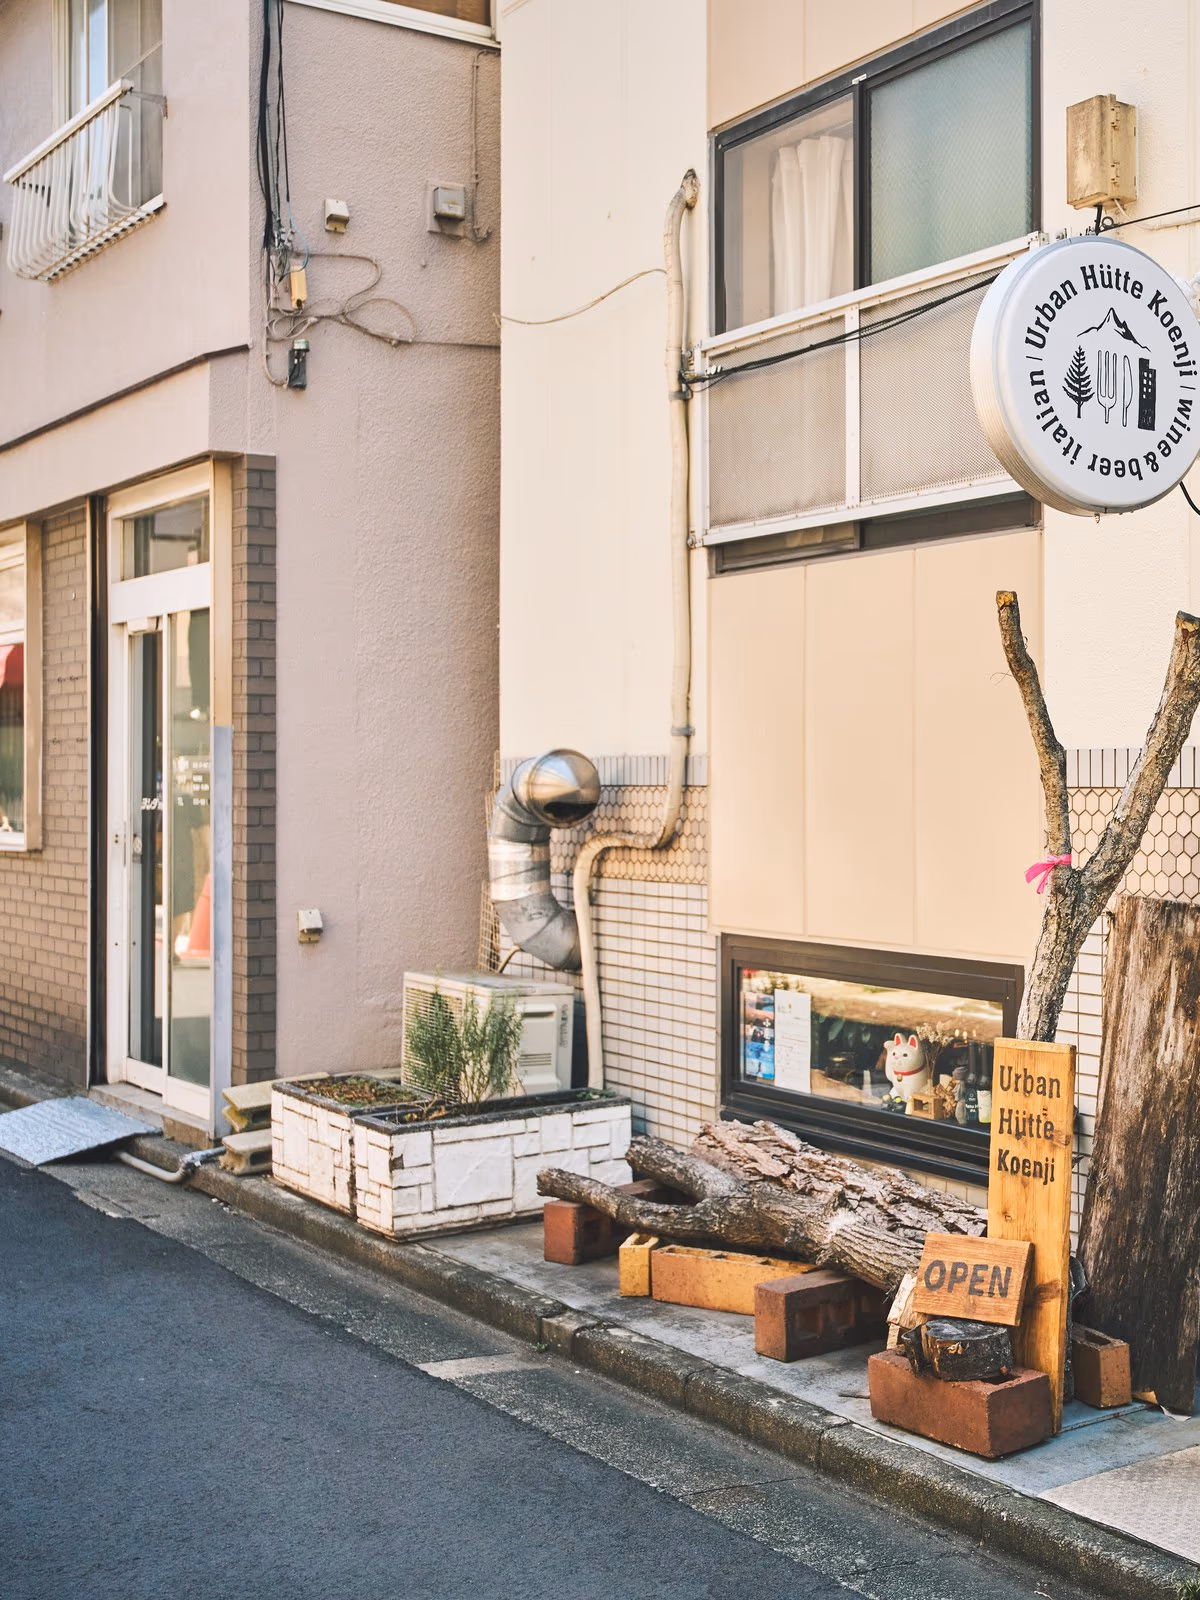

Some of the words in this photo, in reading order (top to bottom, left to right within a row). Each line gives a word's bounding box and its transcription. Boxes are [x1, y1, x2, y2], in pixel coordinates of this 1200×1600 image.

[1079, 263, 1144, 299] Hütte
[1024, 279, 1079, 349] Urban
[1146, 289, 1198, 378] Koenji
[1029, 369, 1083, 465] italian
[999, 1064, 1061, 1099] Urban
[998, 1107, 1055, 1141] Hütte
[997, 1148, 1056, 1186] Koenji
[923, 1259, 1013, 1299] OPEN
